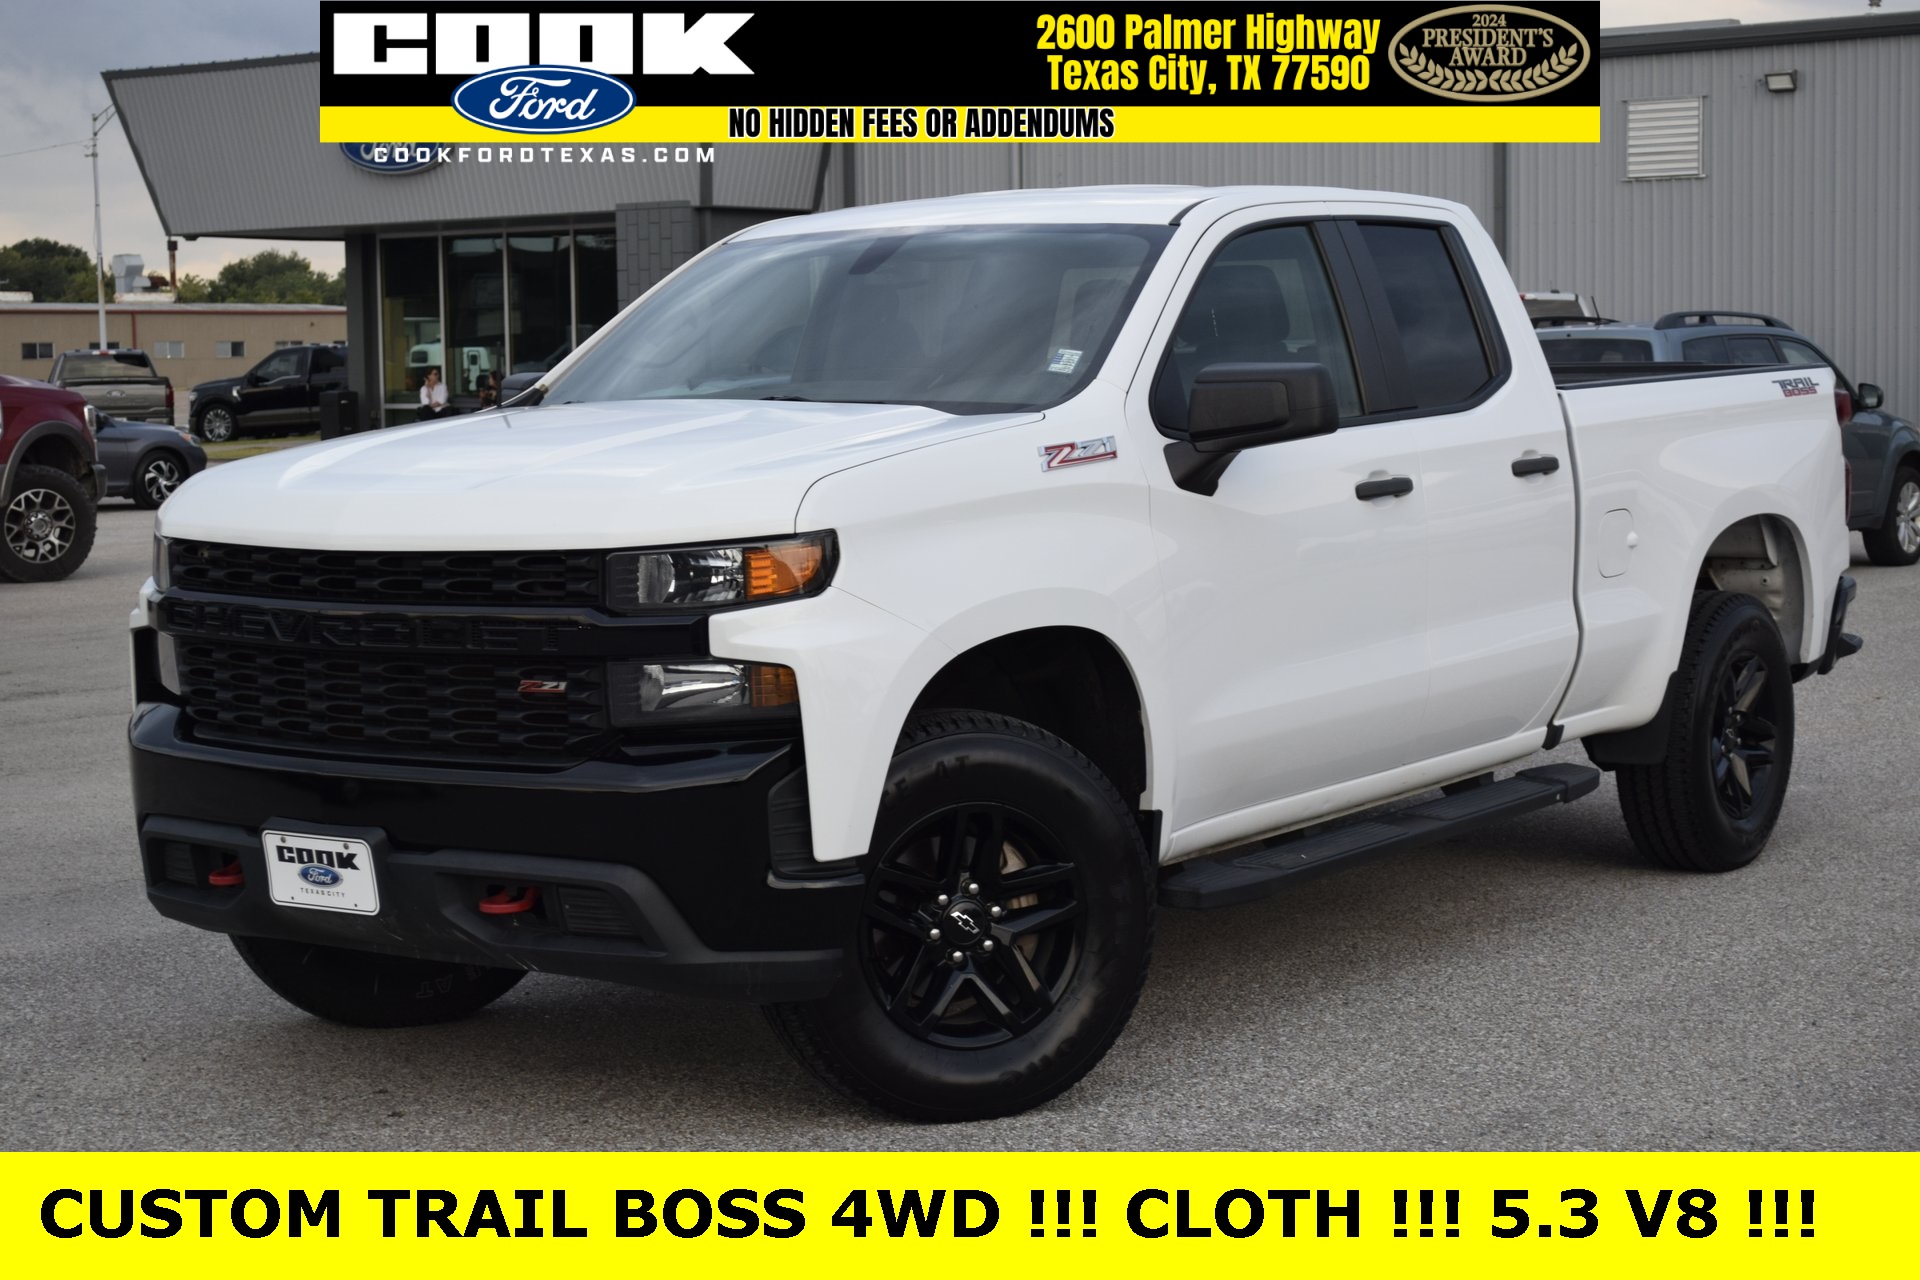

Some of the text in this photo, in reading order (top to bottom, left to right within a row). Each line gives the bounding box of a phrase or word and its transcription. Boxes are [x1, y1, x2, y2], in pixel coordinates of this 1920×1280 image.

[1771, 377, 1819, 389] TRAIL
[1783, 386, 1817, 397] BOSS
[165, 597, 580, 652] CHEVROLET
[276, 845, 360, 871] COOK
[307, 868, 333, 884] Ford
